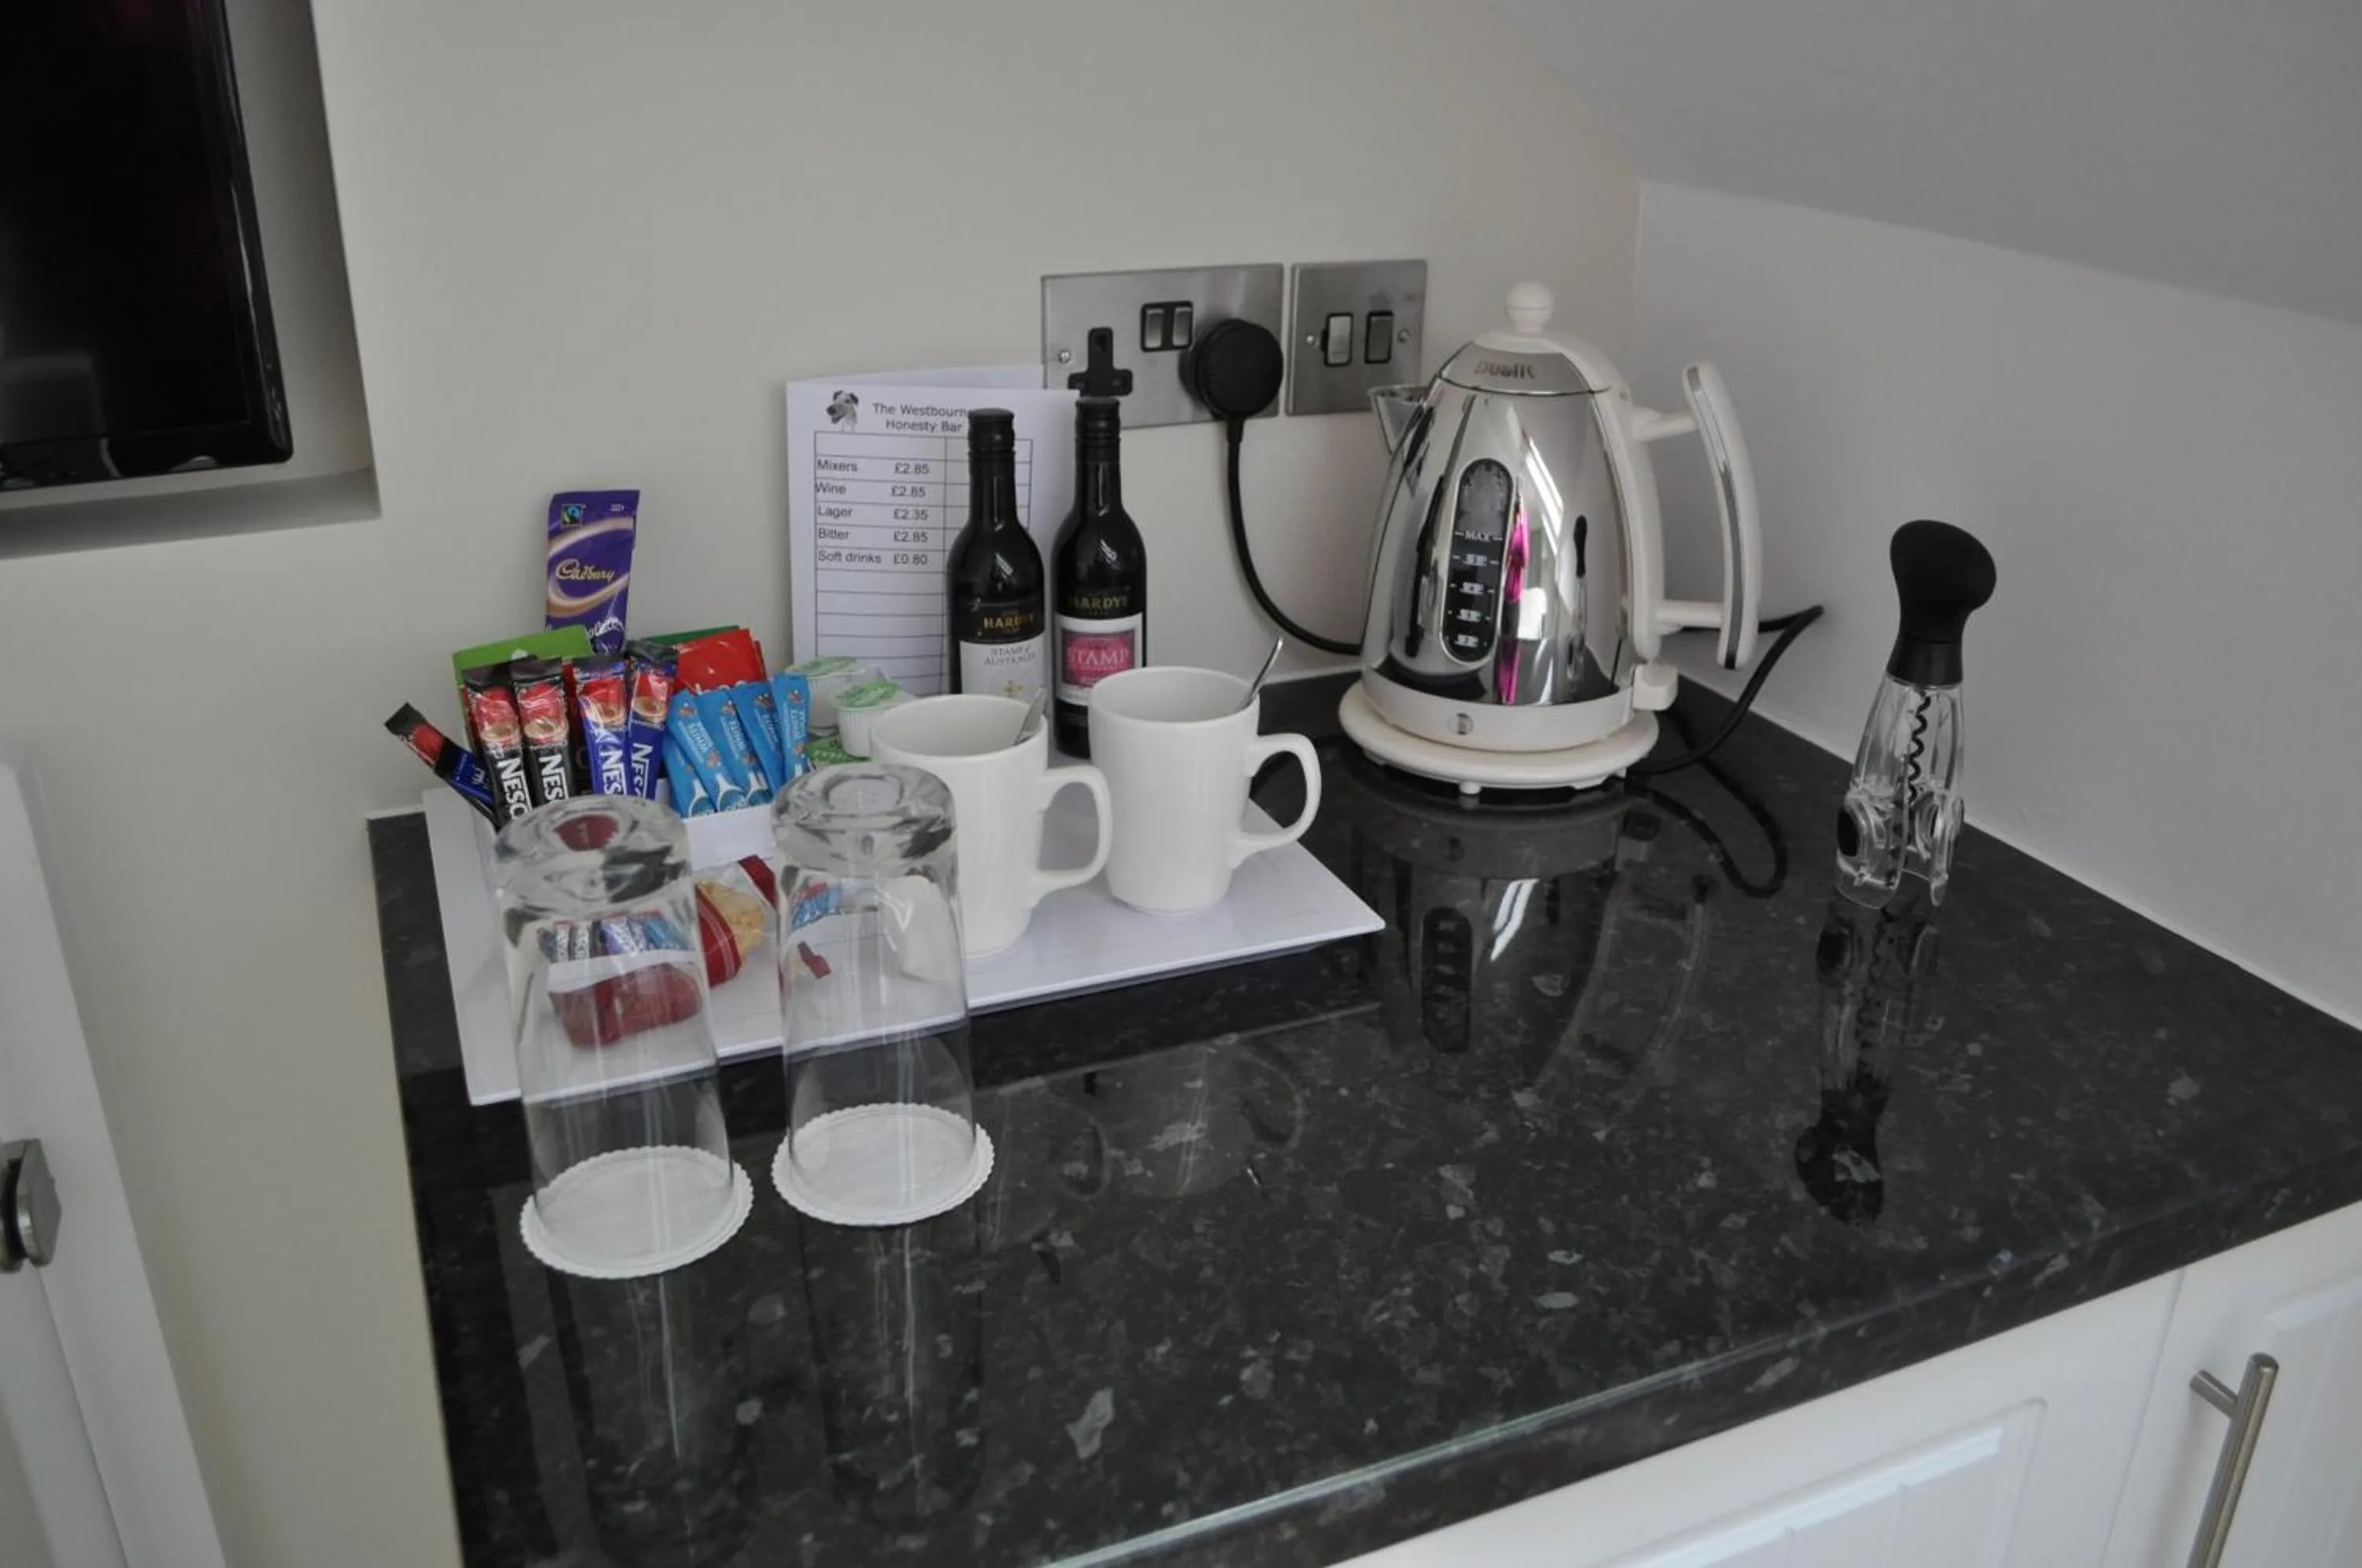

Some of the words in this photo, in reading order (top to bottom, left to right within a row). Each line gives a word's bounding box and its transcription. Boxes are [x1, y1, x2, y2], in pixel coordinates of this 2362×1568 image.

[873, 402, 895, 415] The
[900, 403, 969, 417] Westbourn
[885, 420, 937, 432] Honesty
[941, 421, 963, 432] Bar
[816, 459, 858, 472] Mixers
[894, 462, 930, 475] £2.85
[815, 482, 846, 495] Wine
[891, 485, 927, 497] £2.85
[817, 506, 853, 519] Lager
[894, 508, 928, 520] £2.35
[818, 528, 850, 540] Bitter
[894, 531, 928, 543] £2.85
[1464, 530, 1491, 543] MAX
[817, 550, 842, 562] Soft
[845, 552, 882, 564] drinks
[894, 553, 928, 565] £0.80
[555, 558, 615, 582] Cadbury
[1068, 647, 1129, 667] STAMP
